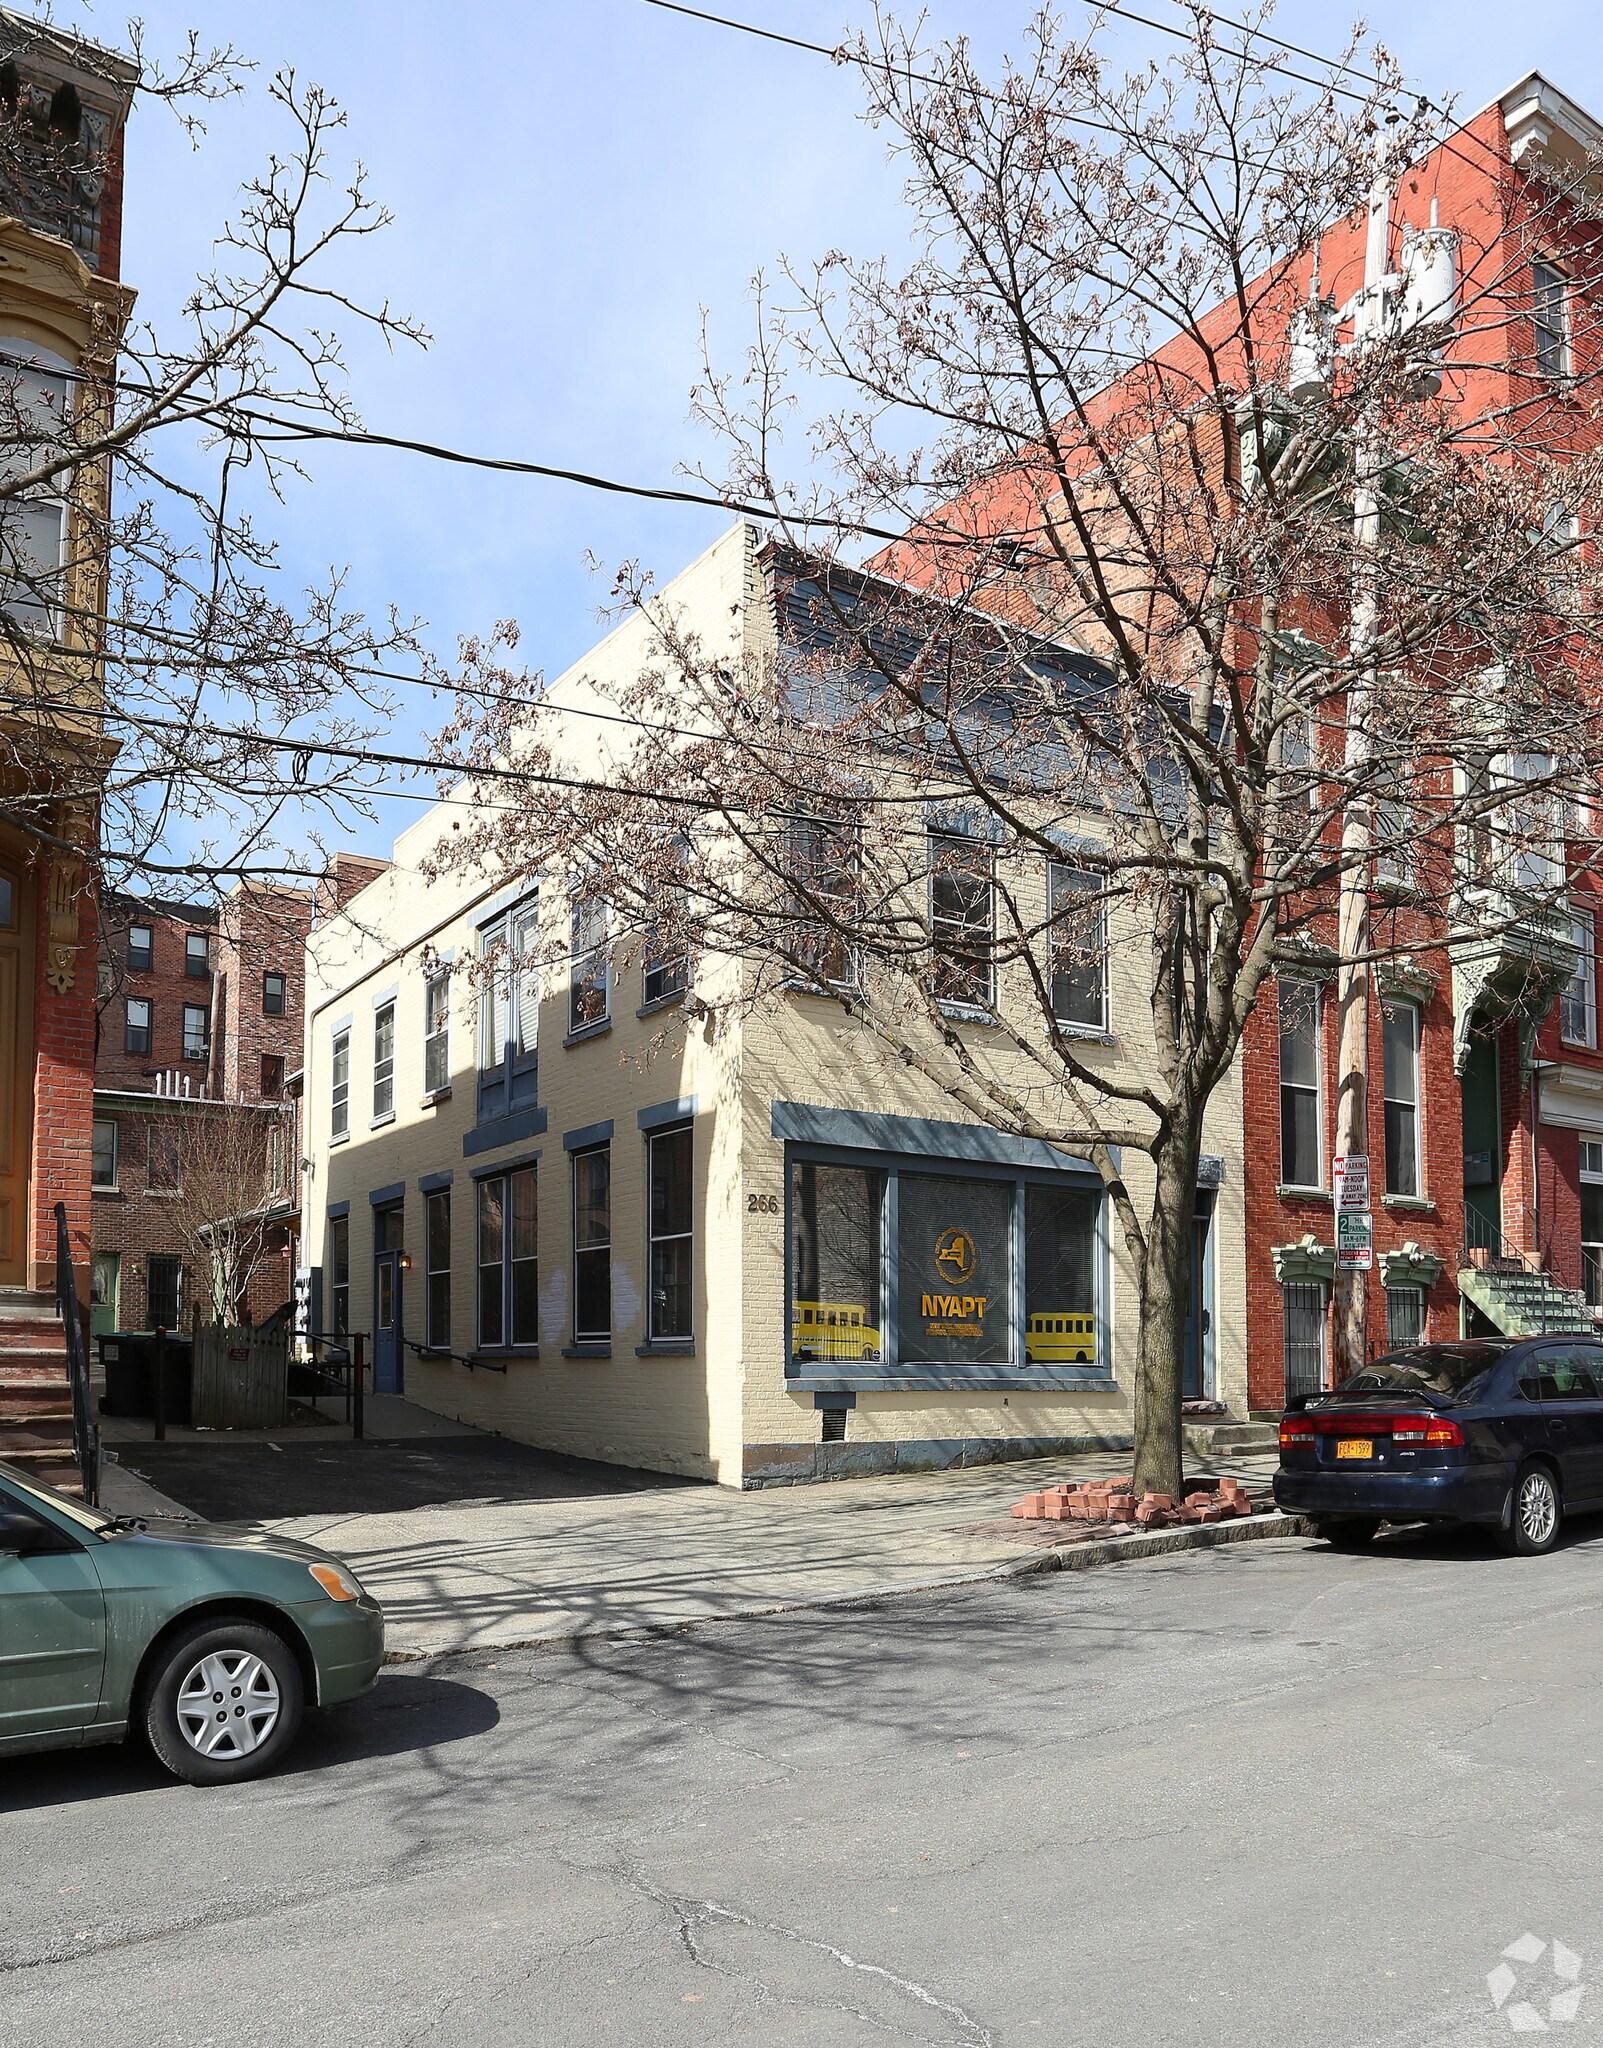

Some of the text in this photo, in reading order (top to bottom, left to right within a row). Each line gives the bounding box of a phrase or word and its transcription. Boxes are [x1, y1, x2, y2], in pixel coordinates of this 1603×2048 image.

[1335, 1161, 1366, 1171] NO PARKING
[1339, 1175, 1364, 1183] 9AM-NOON
[1341, 1184, 1363, 1192] TUESDAY
[748, 1194, 778, 1213] 266
[1340, 1218, 1347, 1231] 2
[1349, 1224, 1369, 1232] PARKING
[922, 1294, 987, 1319] NYAPT
